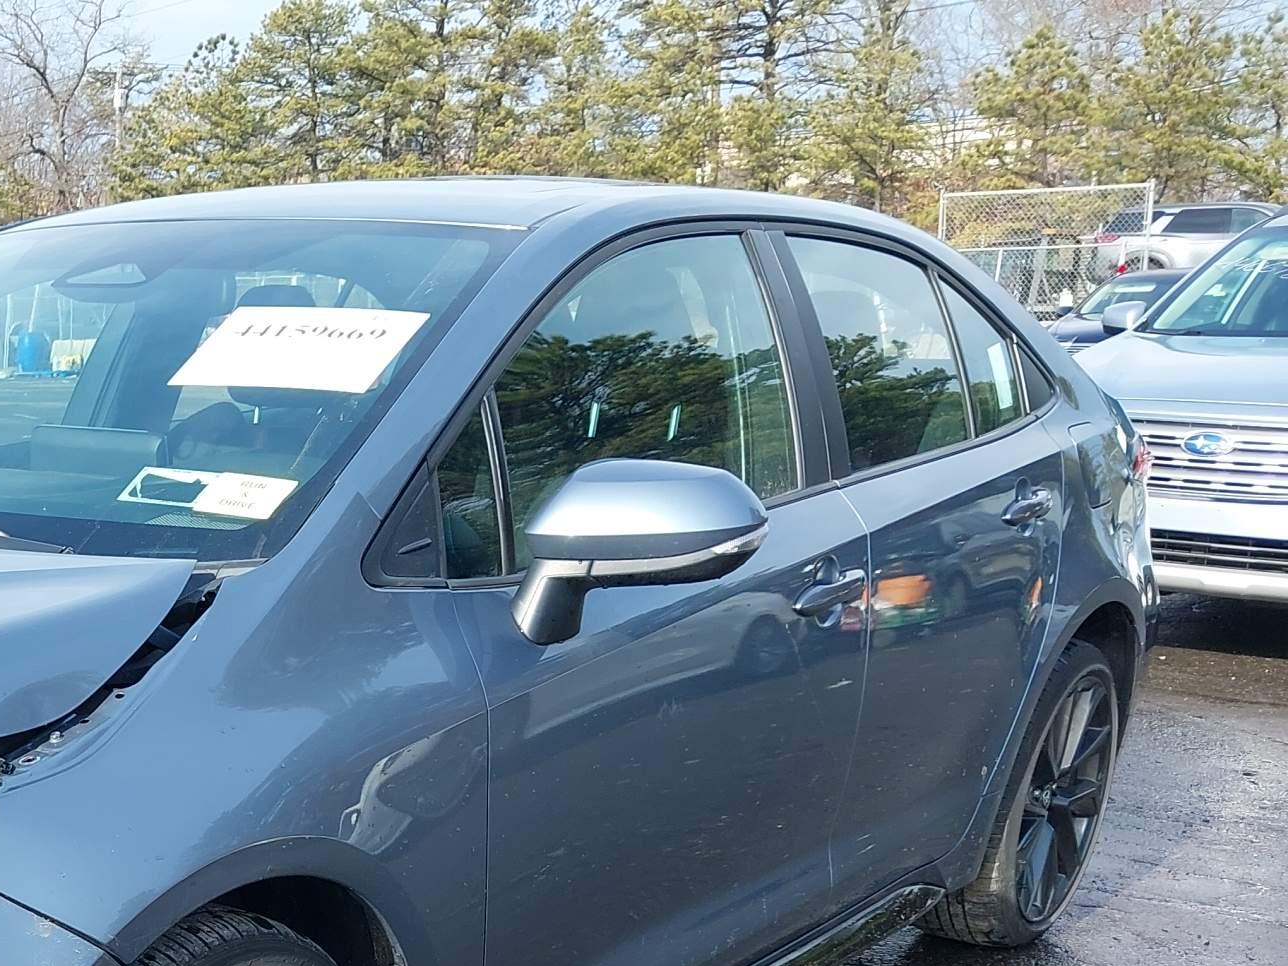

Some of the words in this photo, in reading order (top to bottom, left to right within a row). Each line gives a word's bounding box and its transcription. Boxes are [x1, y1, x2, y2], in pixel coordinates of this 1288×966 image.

[235, 324, 388, 340] 44159669
[240, 480, 268, 490] RUN
[219, 498, 256, 509] DRIVE
